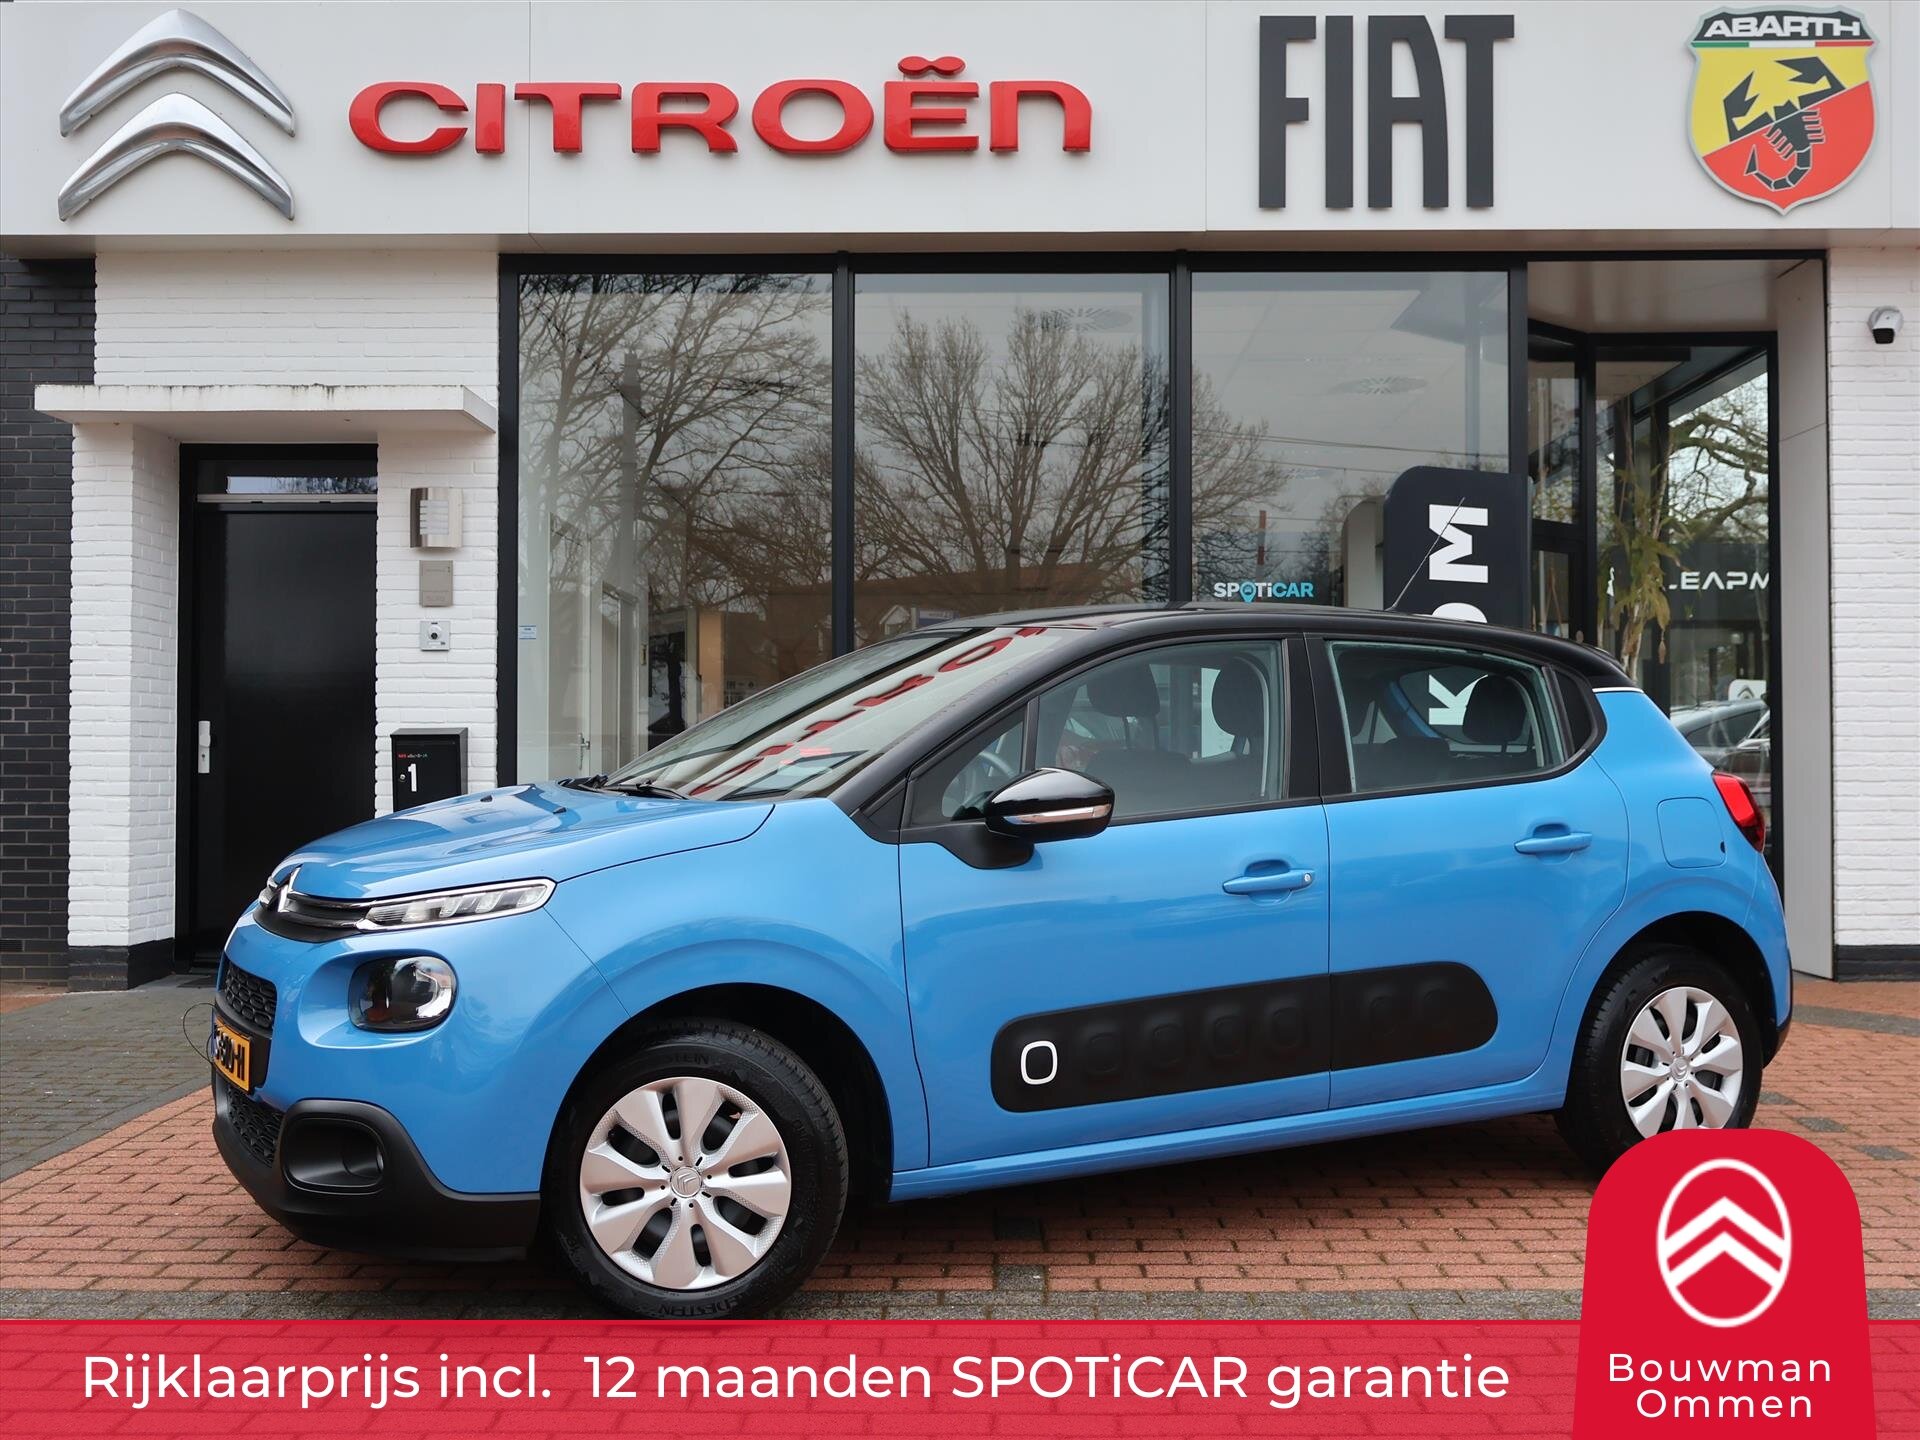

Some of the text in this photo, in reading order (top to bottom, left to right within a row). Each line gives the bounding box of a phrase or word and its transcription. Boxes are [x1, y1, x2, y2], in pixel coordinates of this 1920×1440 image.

[1703, 15, 1861, 38] ABARTH
[348, 55, 1093, 155] CITROËN
[1258, 15, 1515, 209] FIAT
[407, 763, 418, 792] 1
